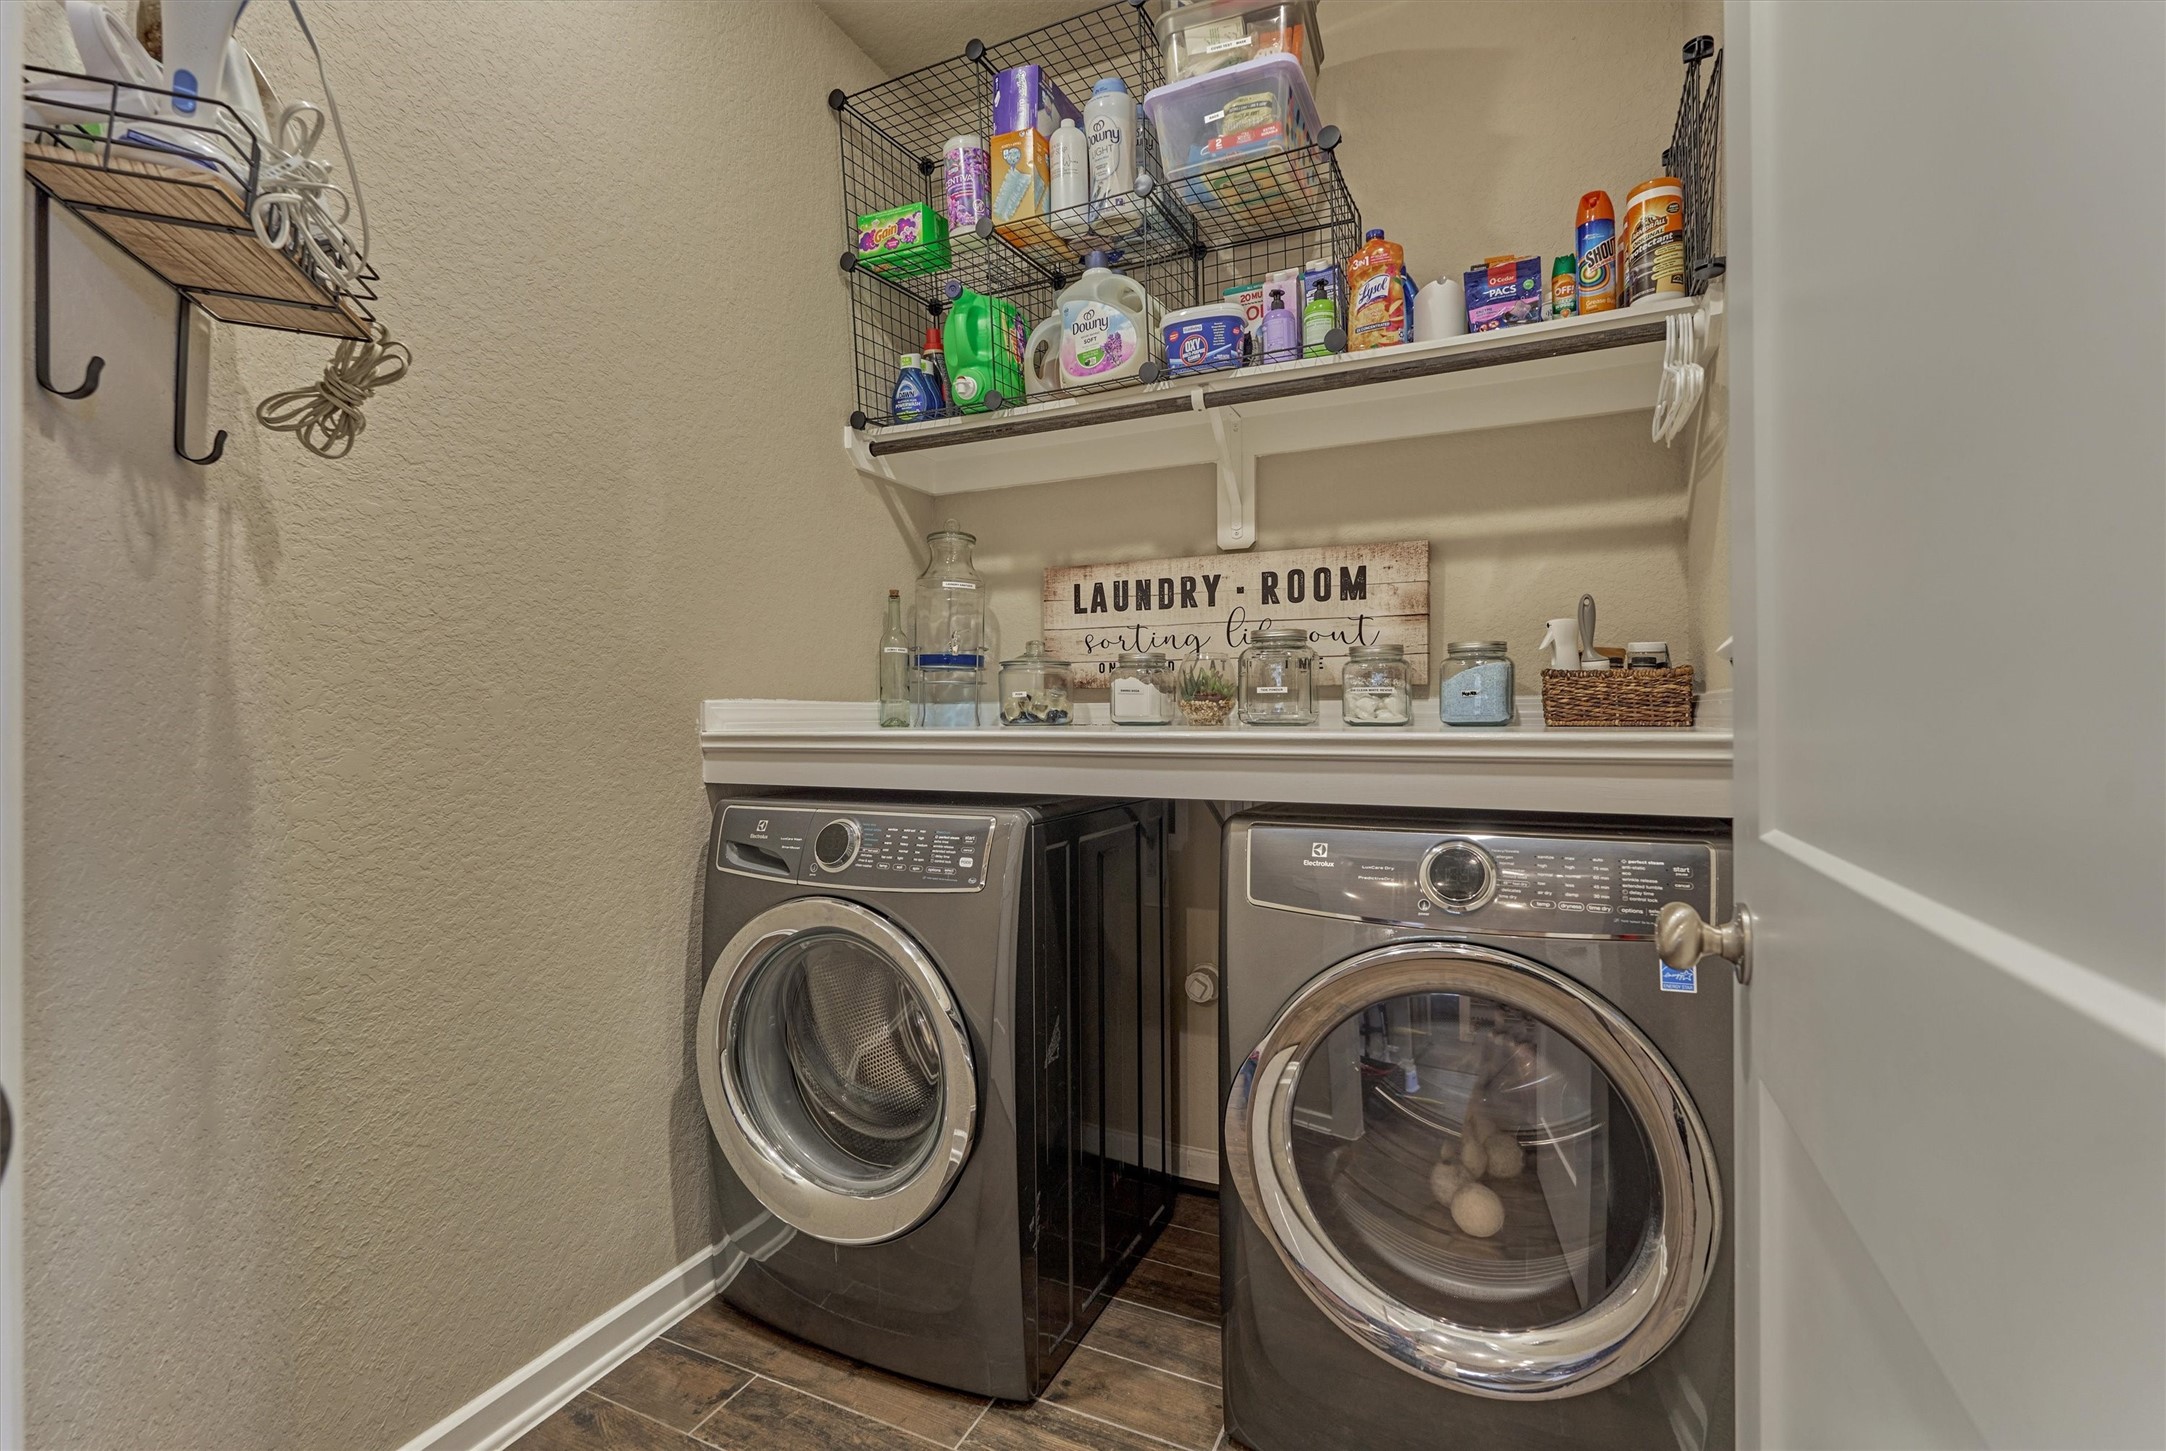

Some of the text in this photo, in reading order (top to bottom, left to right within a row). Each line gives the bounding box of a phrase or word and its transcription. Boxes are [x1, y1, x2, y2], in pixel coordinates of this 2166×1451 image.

[1215, 138, 1222, 147] 2
[946, 174, 974, 190] CENTIVA
[874, 223, 897, 243] Gain
[1586, 238, 1615, 268] SHOU
[1358, 277, 1388, 305] Lysol
[1489, 284, 1517, 297] PACS
[1555, 285, 1575, 296] OFF!
[1240, 293, 1251, 304] 20
[1072, 316, 1109, 336] Downy
[1361, 321, 1391, 332] CONCENTRATED
[1083, 336, 1097, 345] SOFT
[1184, 338, 1201, 353] OXY
[899, 391, 915, 399] DAWN
[1073, 565, 1368, 614] LAUNDRY ROOM
[1085, 623, 1212, 660] sorting
[1309, 614, 1380, 647] out
[1303, 859, 1336, 868] Electrolux
